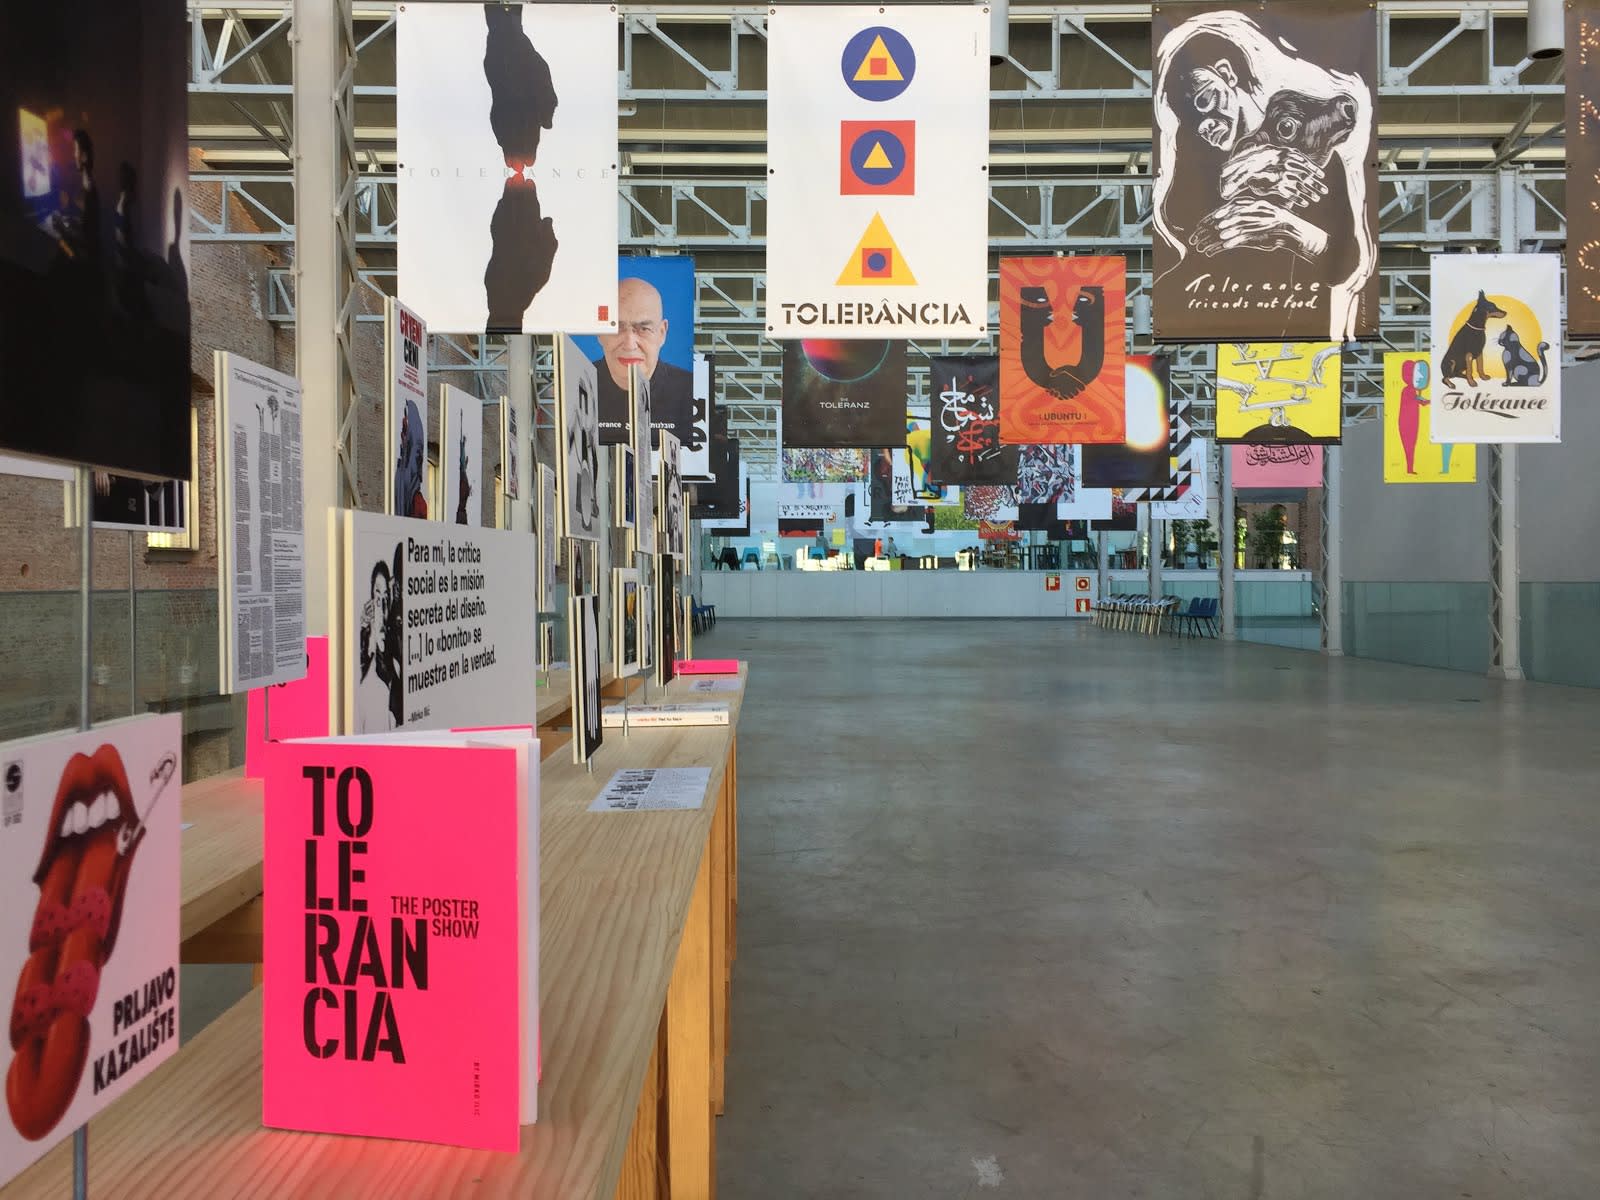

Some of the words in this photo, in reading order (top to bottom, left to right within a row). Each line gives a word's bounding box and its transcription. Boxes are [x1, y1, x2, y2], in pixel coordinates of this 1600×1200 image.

[407, 168, 609, 179] TOLERANCE
[1185, 274, 1321, 293] Tolerance
[781, 298, 972, 325] TOLERÂNCIA
[1188, 297, 1249, 309] friends
[1256, 297, 1280, 309] not
[1284, 294, 1318, 310] food
[1044, 412, 1082, 421] UBUNTU
[1441, 392, 1548, 419] Tolérance
[408, 537, 430, 563] Para
[432, 540, 446, 566] mí,
[448, 540, 456, 563] la
[458, 541, 481, 564] crítica
[408, 570, 436, 596] social
[438, 579, 449, 593] es
[451, 569, 459, 592] la
[460, 569, 485, 592] misión
[408, 603, 443, 628] secreta
[445, 597, 459, 621] del
[461, 595, 486, 619] diseño.
[425, 632, 434, 656] lo
[436, 626, 471, 653] «bonito»
[473, 627, 482, 644] se
[408, 663, 447, 694] muestra
[449, 659, 460, 679] en
[462, 653, 469, 675] la
[470, 644, 497, 669] verdad.
[302, 766, 374, 838] TO
[304, 839, 368, 912] LE
[390, 896, 419, 915] THE
[422, 897, 480, 920] POSTER
[432, 918, 480, 939] SHOW
[304, 912, 429, 991] RAN
[113, 966, 176, 1037] PRLJAVO
[302, 986, 407, 1065] CIA
[93, 1006, 175, 1096] KAZALIŠTE
